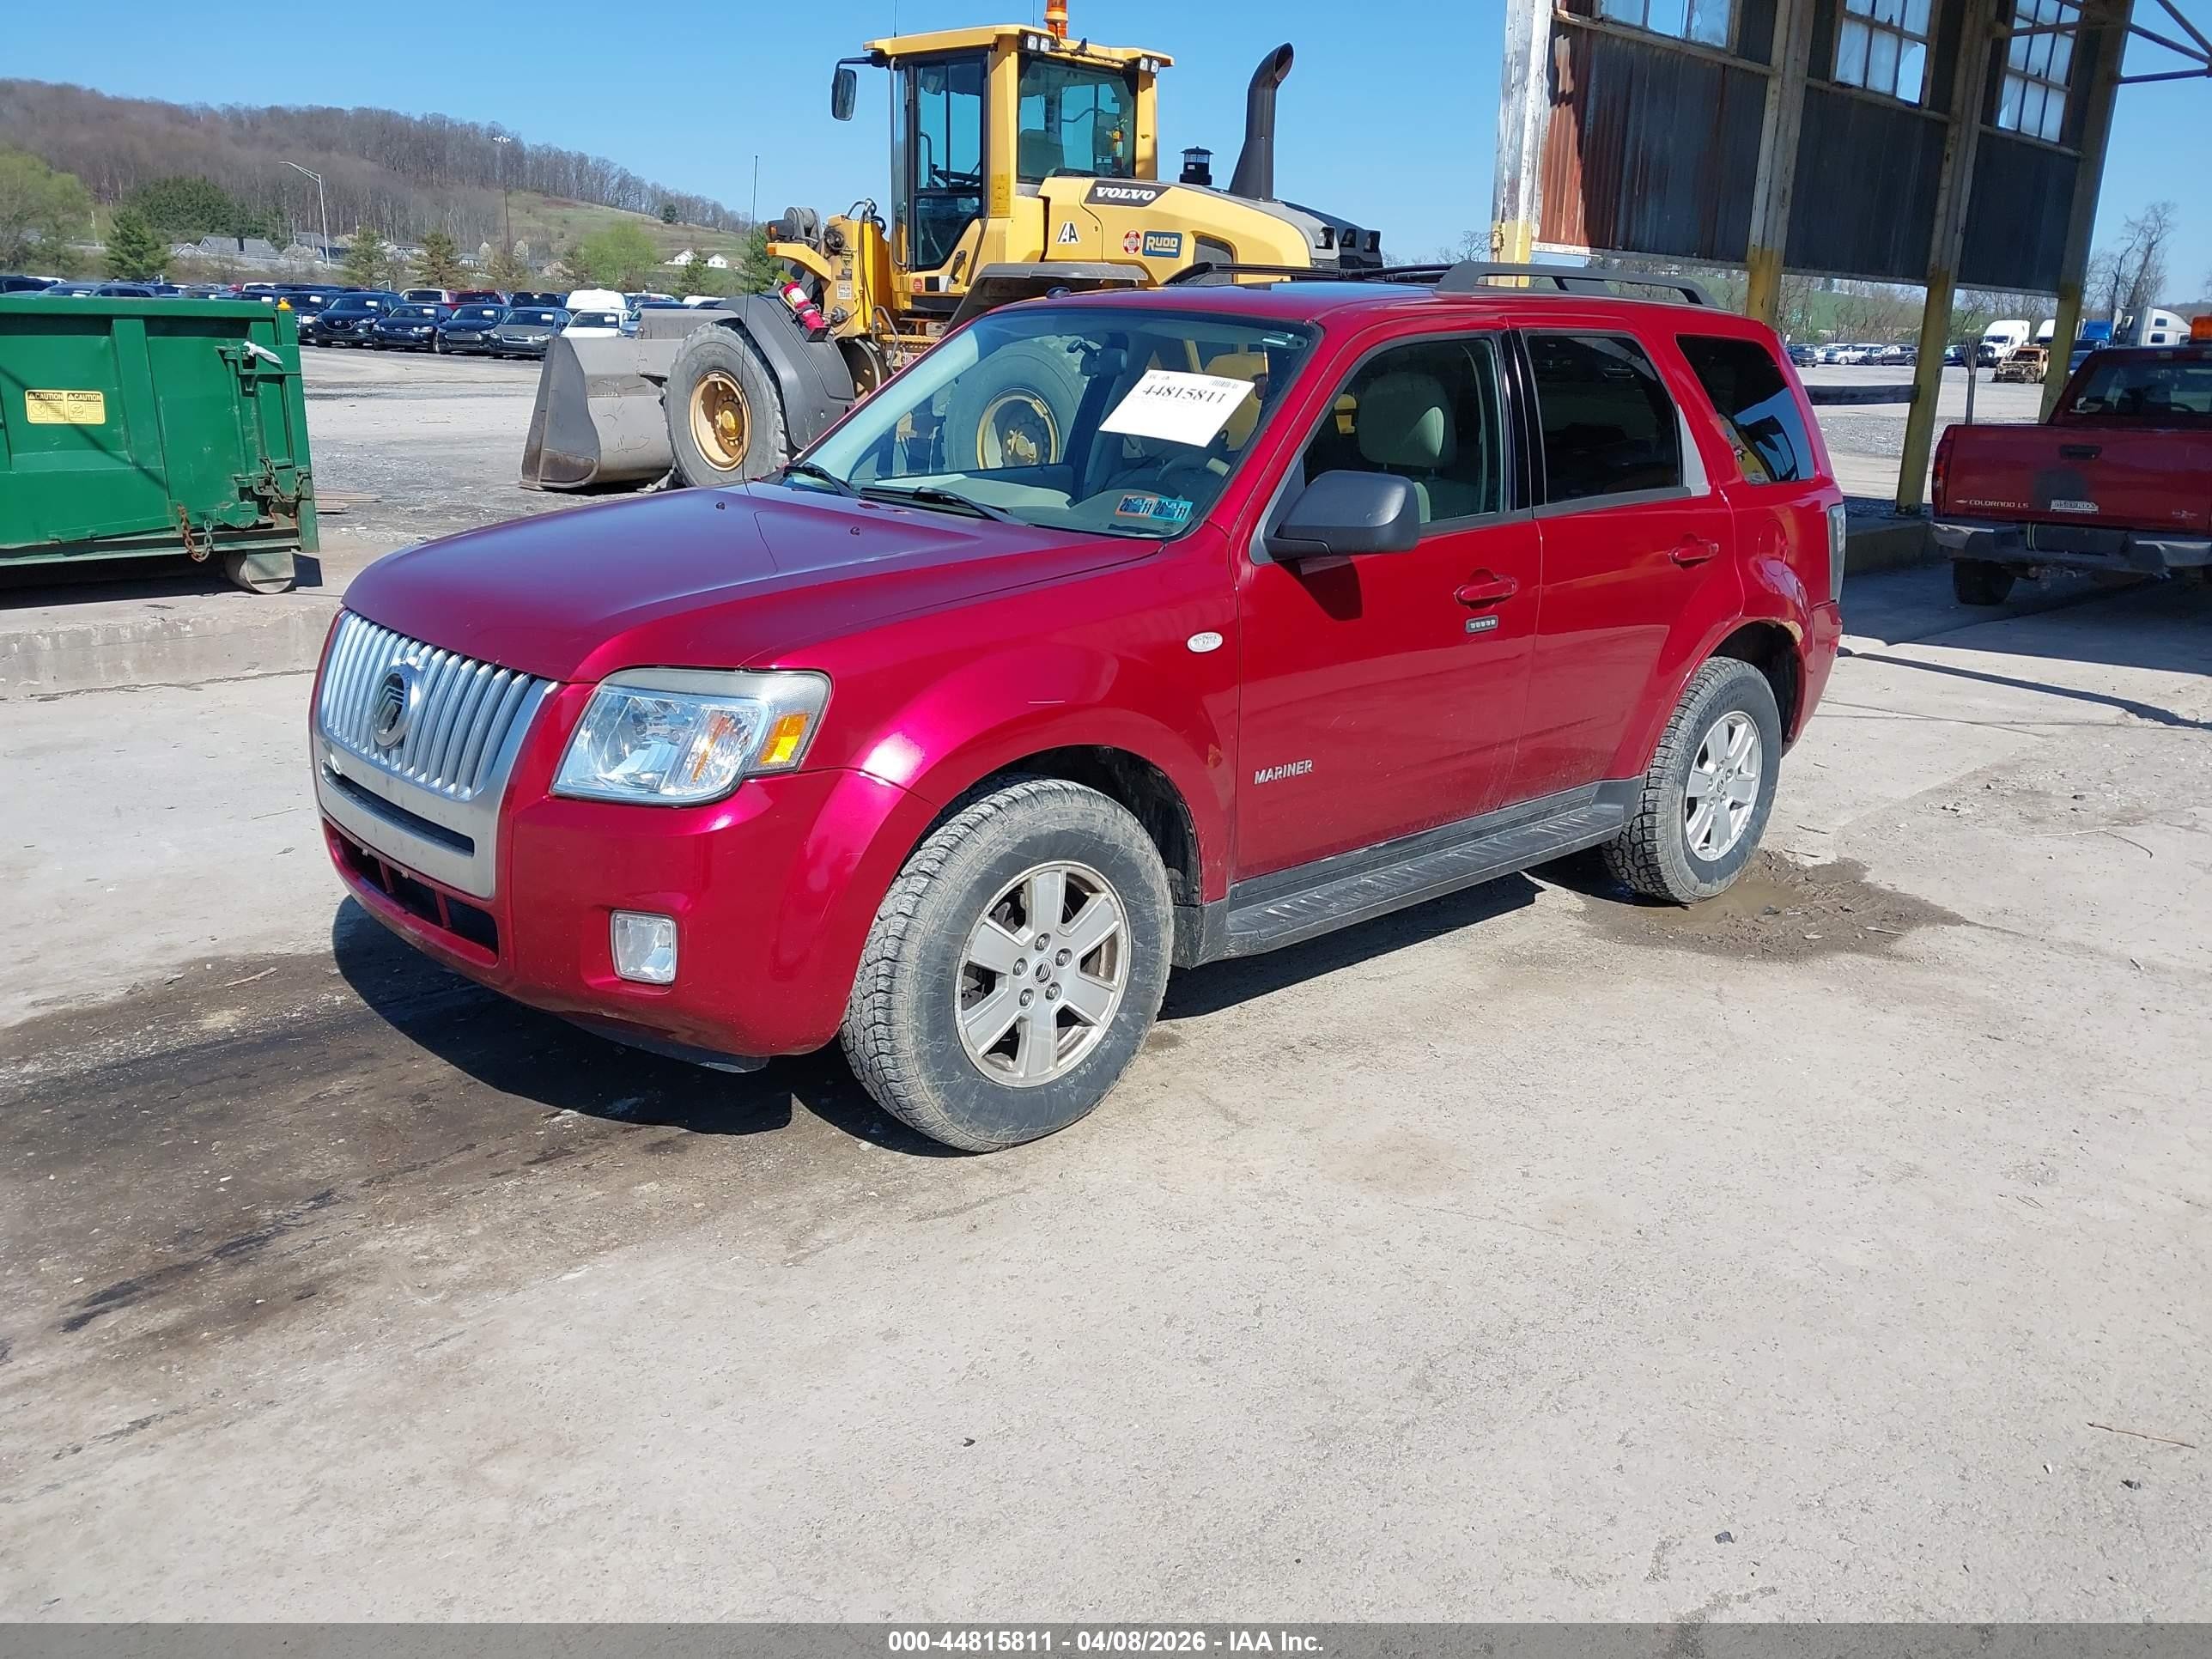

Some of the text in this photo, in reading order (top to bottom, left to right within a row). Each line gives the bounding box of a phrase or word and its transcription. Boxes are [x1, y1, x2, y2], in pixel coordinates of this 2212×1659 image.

[1096, 186, 1156, 201] VOLVO
[1146, 235, 1179, 252] RUDD
[1142, 384, 1227, 404] 44815811
[1969, 499, 2015, 508] COLORADO
[1254, 759, 1313, 785] MARINER
